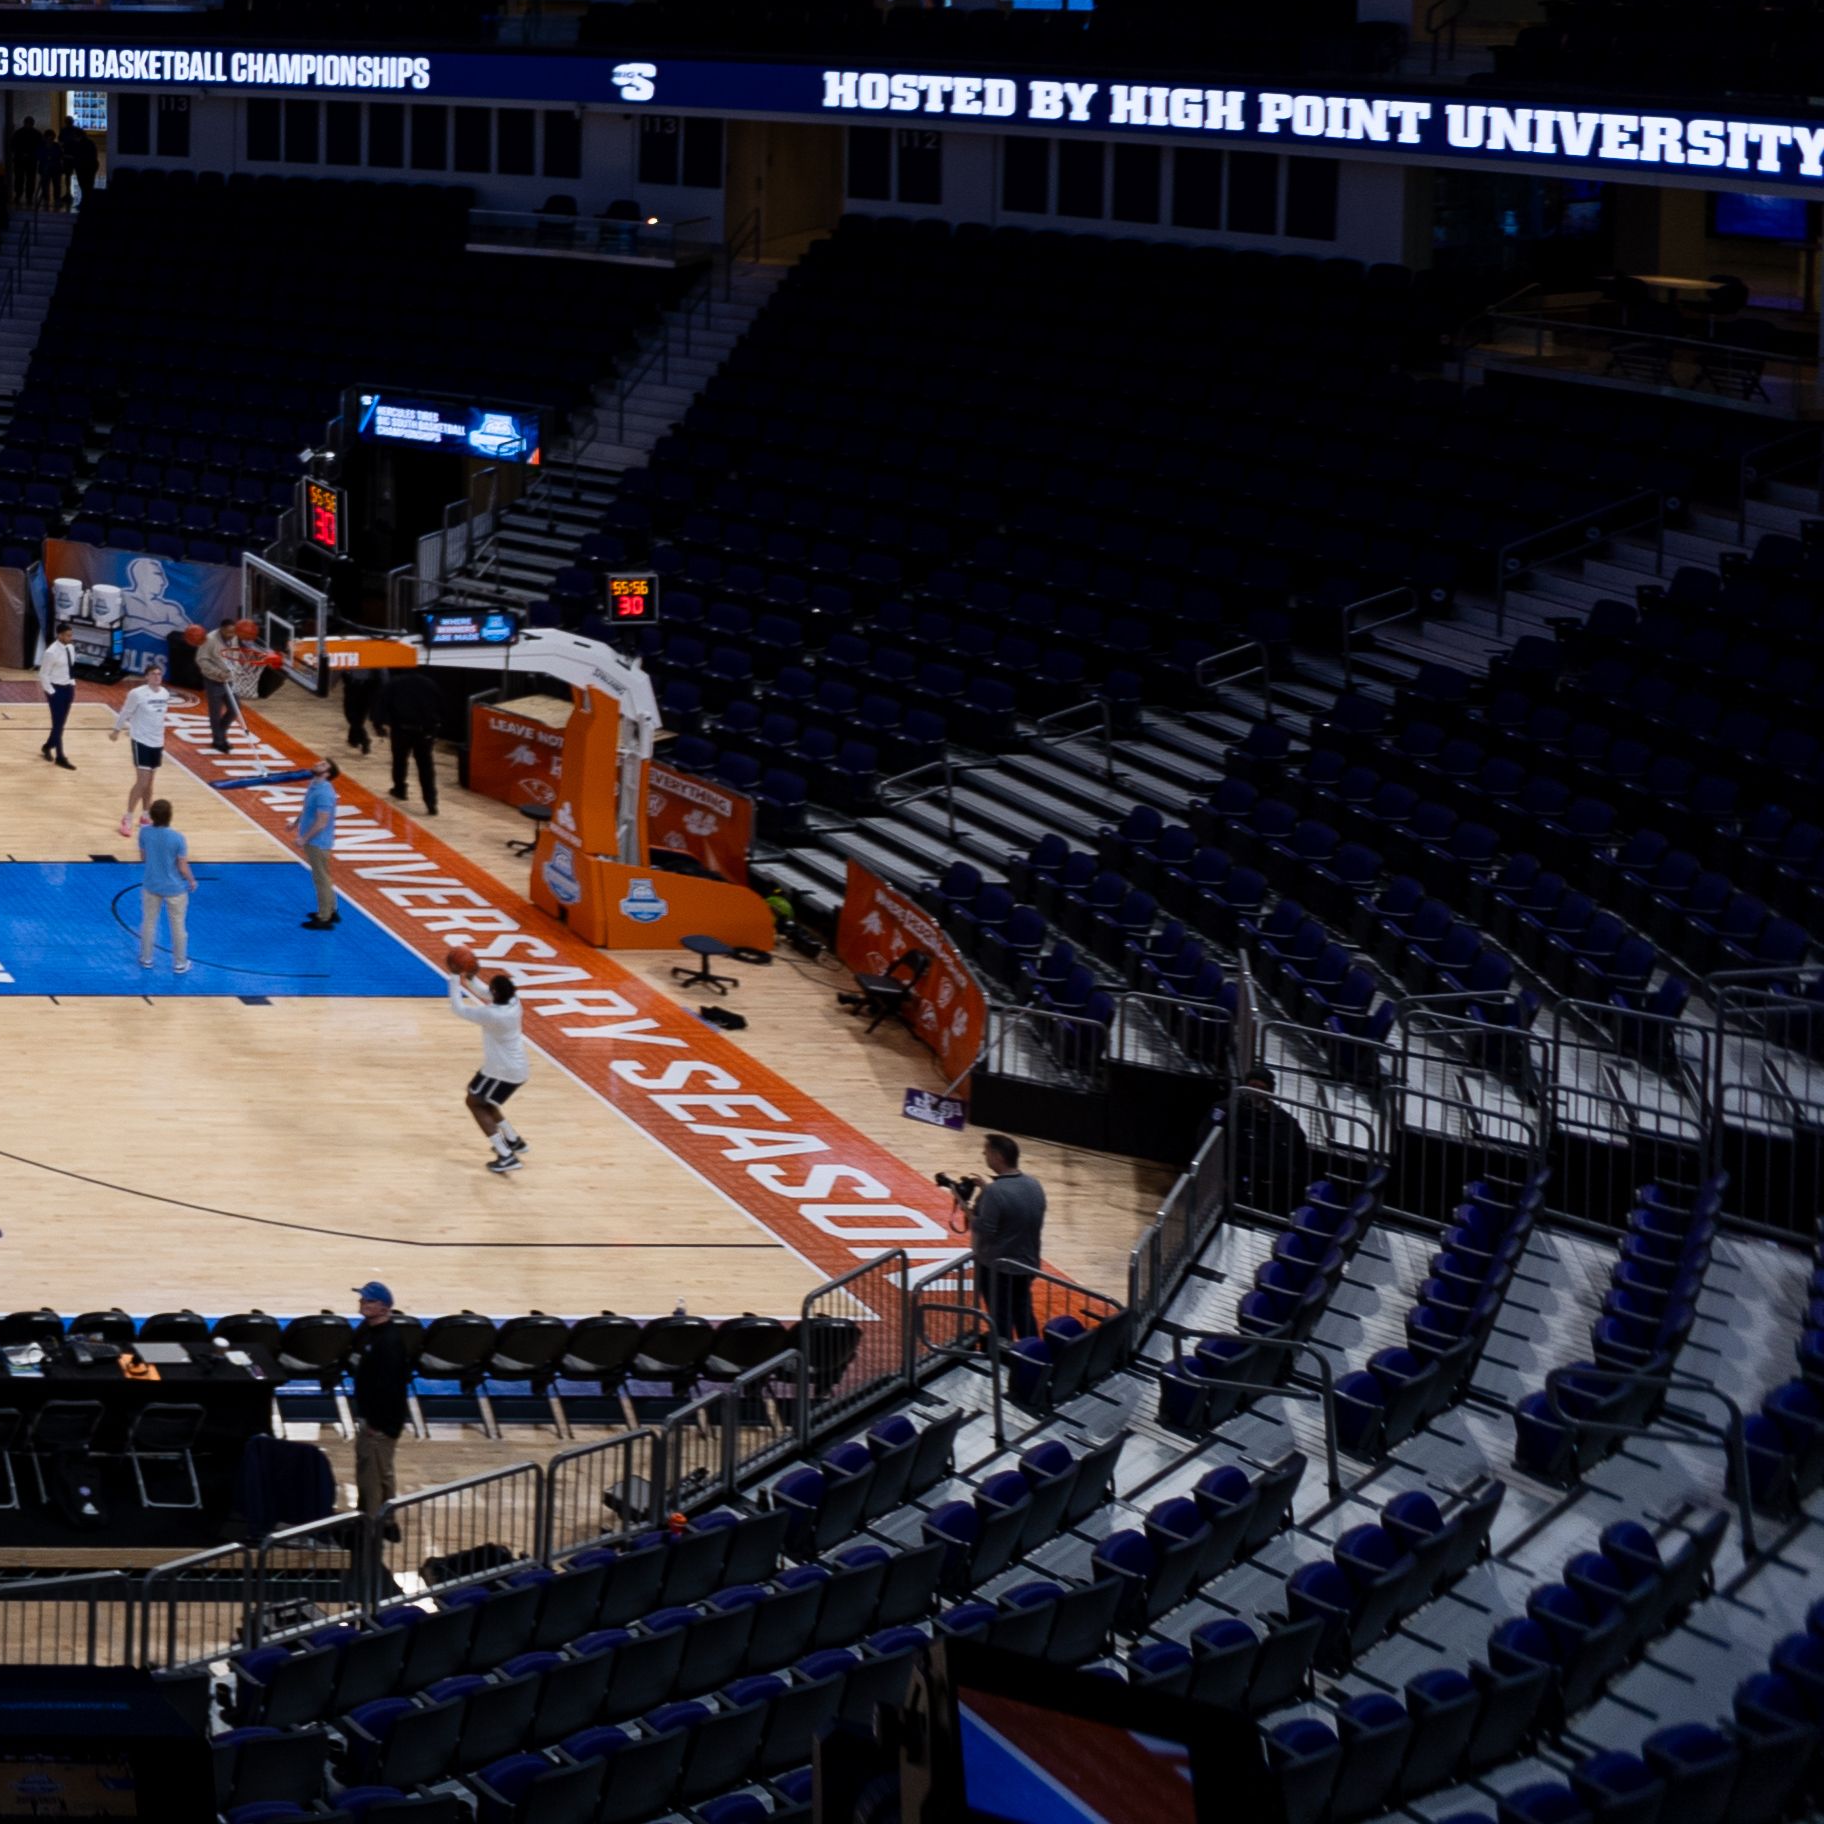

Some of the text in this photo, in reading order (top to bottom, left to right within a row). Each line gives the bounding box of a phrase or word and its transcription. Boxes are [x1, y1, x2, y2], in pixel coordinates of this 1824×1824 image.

[13, 47, 88, 79] SOUTH
[90, 49, 227, 82] BASKETBALL
[231, 51, 430, 90] CHAMPIONSHIPS
[159, 95, 190, 112] 113
[643, 117, 678, 135] 113
[823, 70, 1824, 178] HOSTED BY HIGH POINT UNIVERSITY
[899, 131, 939, 150] 112
[610, 579, 650, 595] 55:56
[617, 596, 645, 616] 30
[489, 717, 534, 742] LEAVE
[609, 1059, 976, 1292] SEASON
